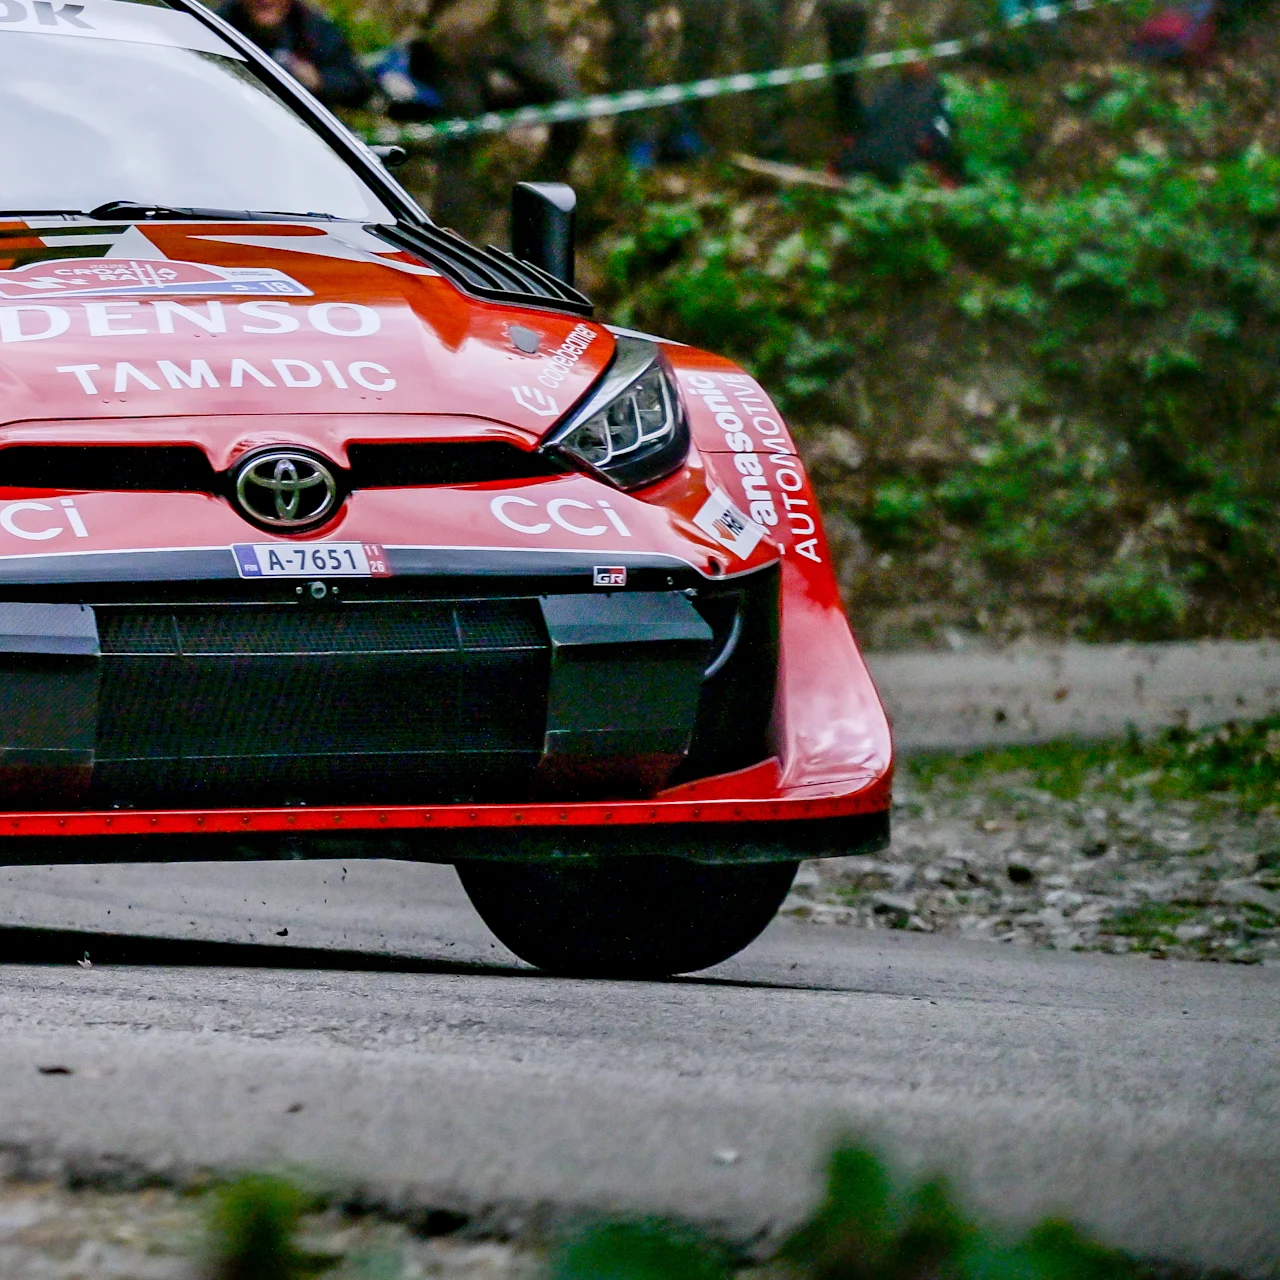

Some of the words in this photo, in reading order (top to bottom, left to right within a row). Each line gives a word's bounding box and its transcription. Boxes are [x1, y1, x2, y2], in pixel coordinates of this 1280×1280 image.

[257, 281, 295, 292] 18
[537, 323, 598, 389] codebeamer
[56, 357, 397, 395] TAMADIC
[718, 373, 822, 564] AUTOMOTIVE
[364, 545, 380, 556] 11
[268, 549, 357, 571] A-7651
[369, 560, 385, 573] 26
[597, 573, 625, 584] GR
